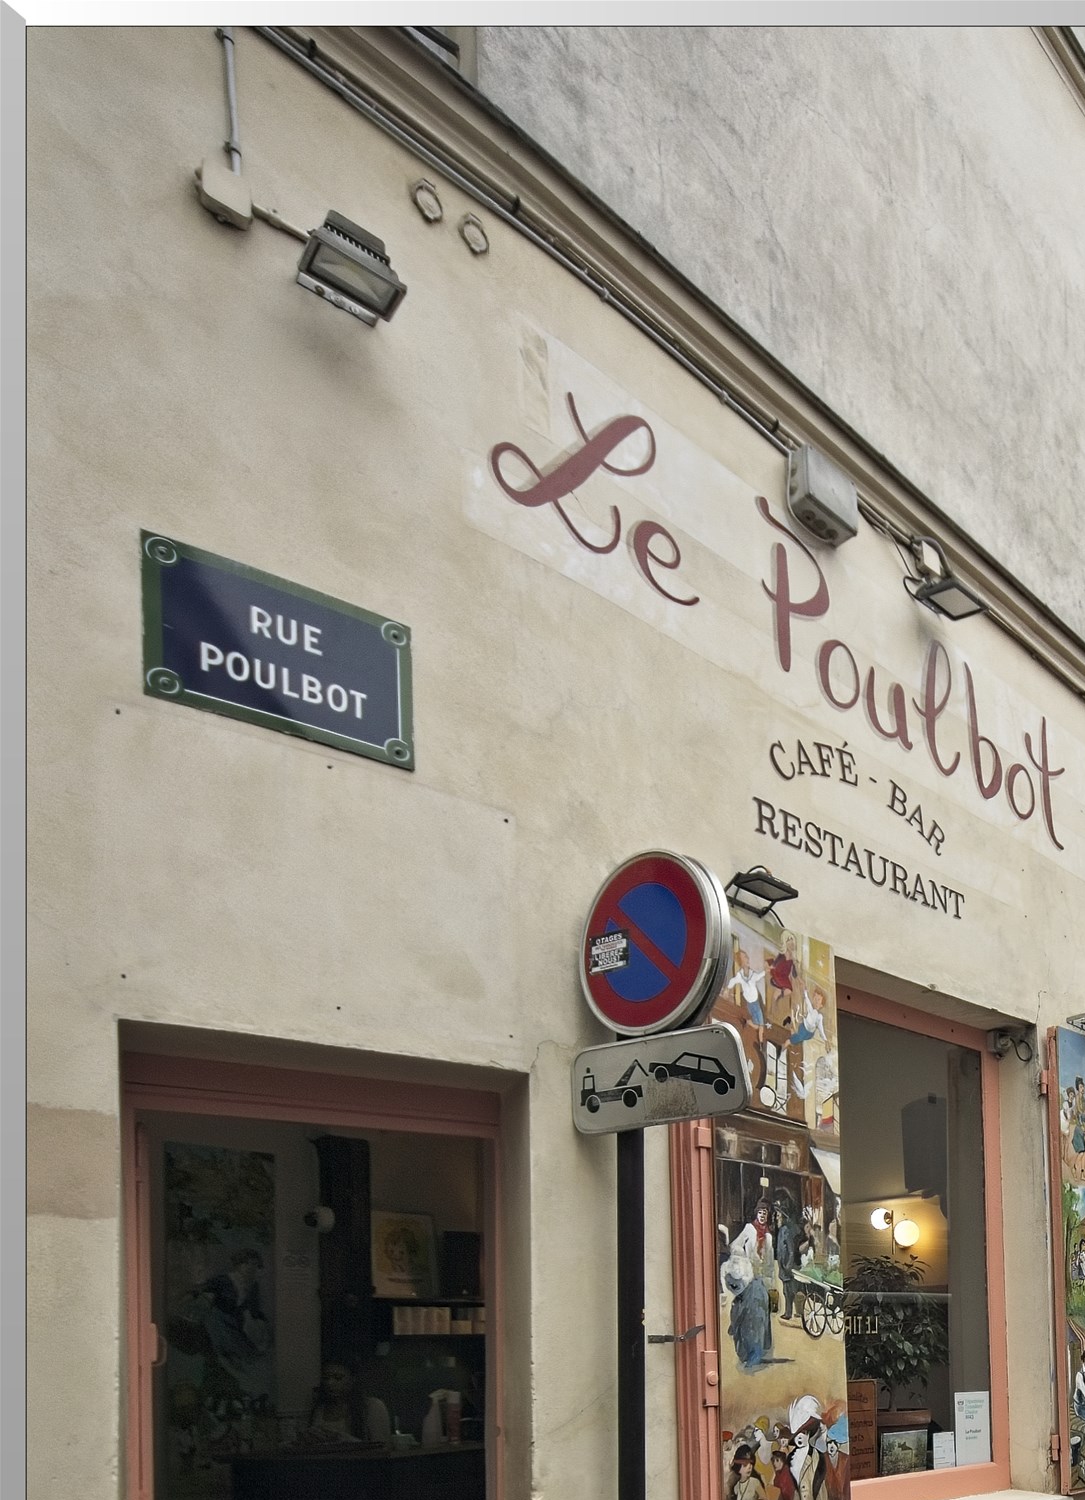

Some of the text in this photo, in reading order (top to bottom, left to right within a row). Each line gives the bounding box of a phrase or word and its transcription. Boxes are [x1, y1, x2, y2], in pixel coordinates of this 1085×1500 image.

[249, 604, 324, 657] RUE
[489, 391, 1066, 851] Le Poulbot
[200, 641, 368, 719] POULBOT
[769, 739, 860, 788] CAFÉ
[887, 780, 947, 857] BAR
[753, 796, 966, 921] RESTAURANT
[595, 932, 622, 945] OTAGES
